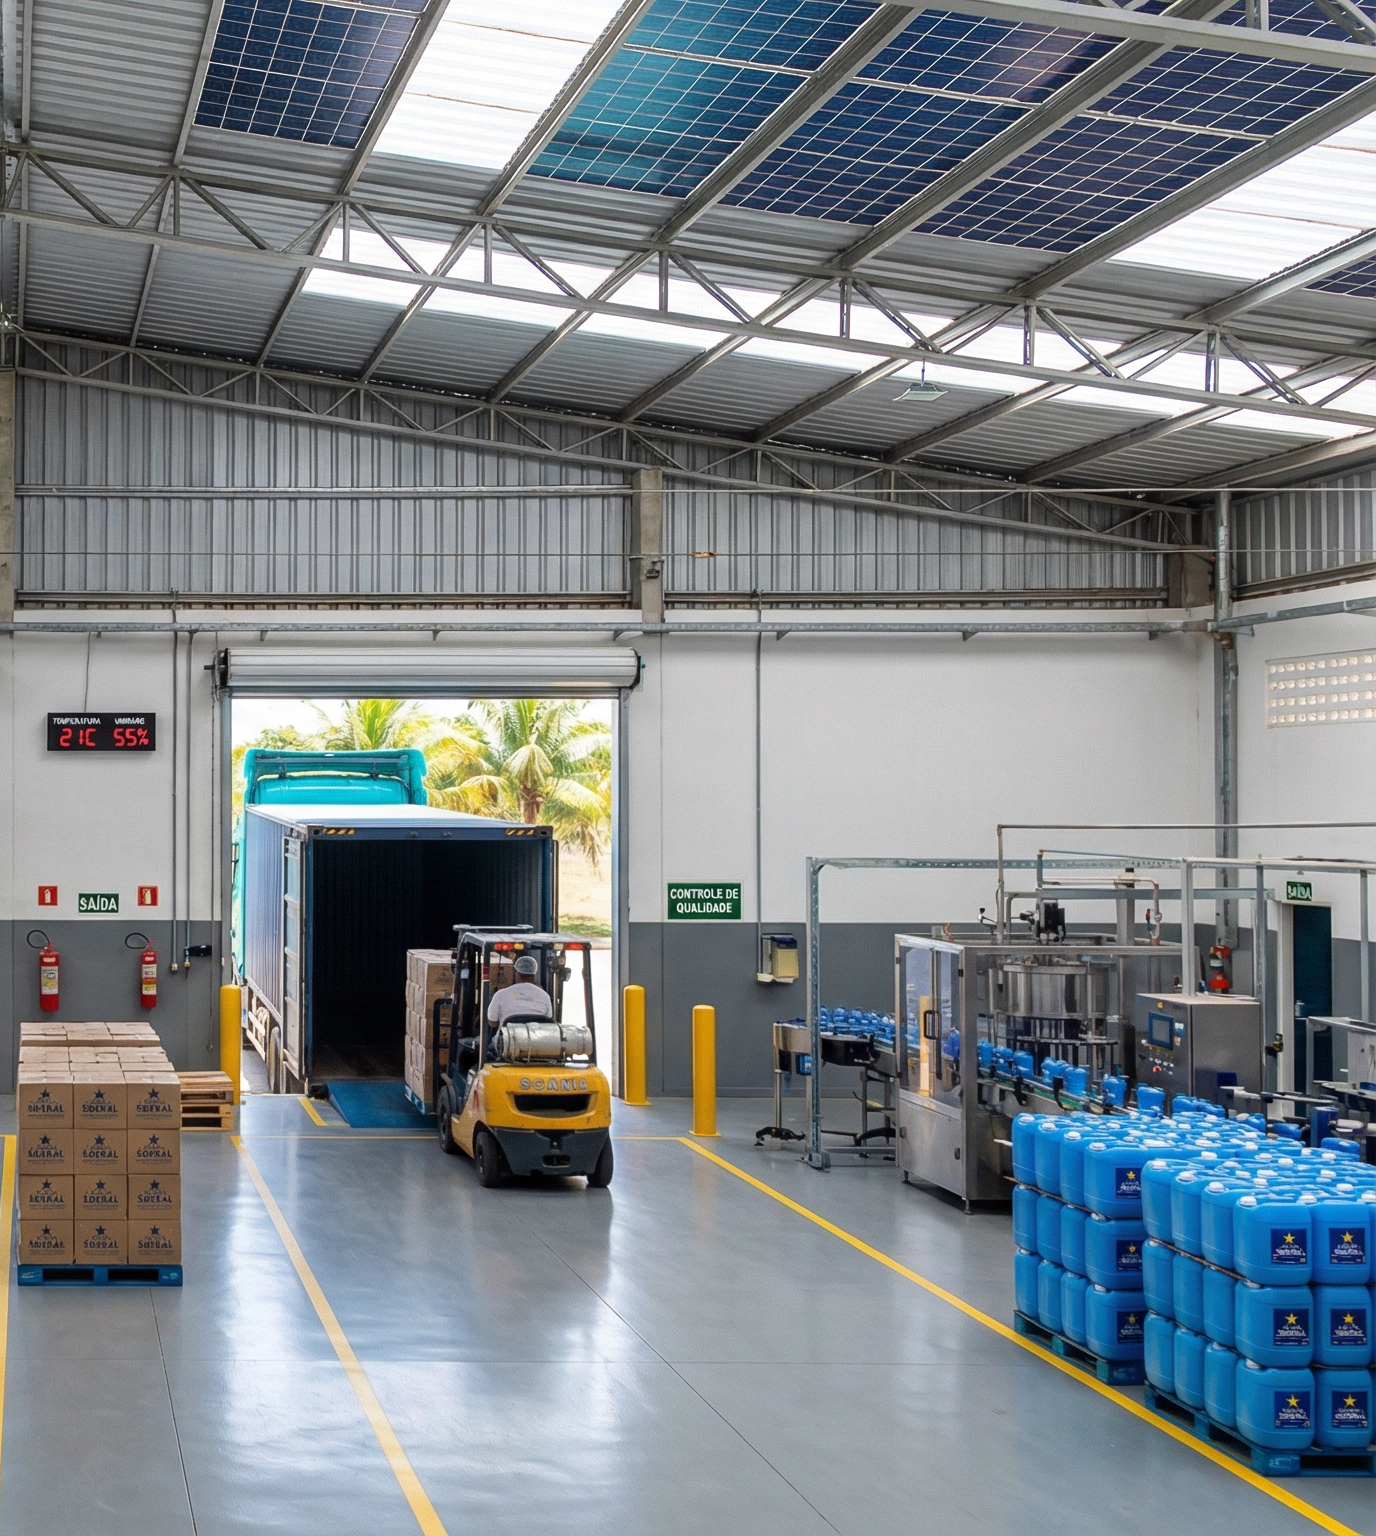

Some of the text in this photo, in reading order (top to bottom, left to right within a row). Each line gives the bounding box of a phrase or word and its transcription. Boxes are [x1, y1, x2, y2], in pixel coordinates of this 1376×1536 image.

[113, 727, 150, 747] 55%
[670, 888, 739, 899] CONTROLE DE
[79, 894, 118, 911] SAÍDA
[519, 1078, 588, 1091] SCANIA
